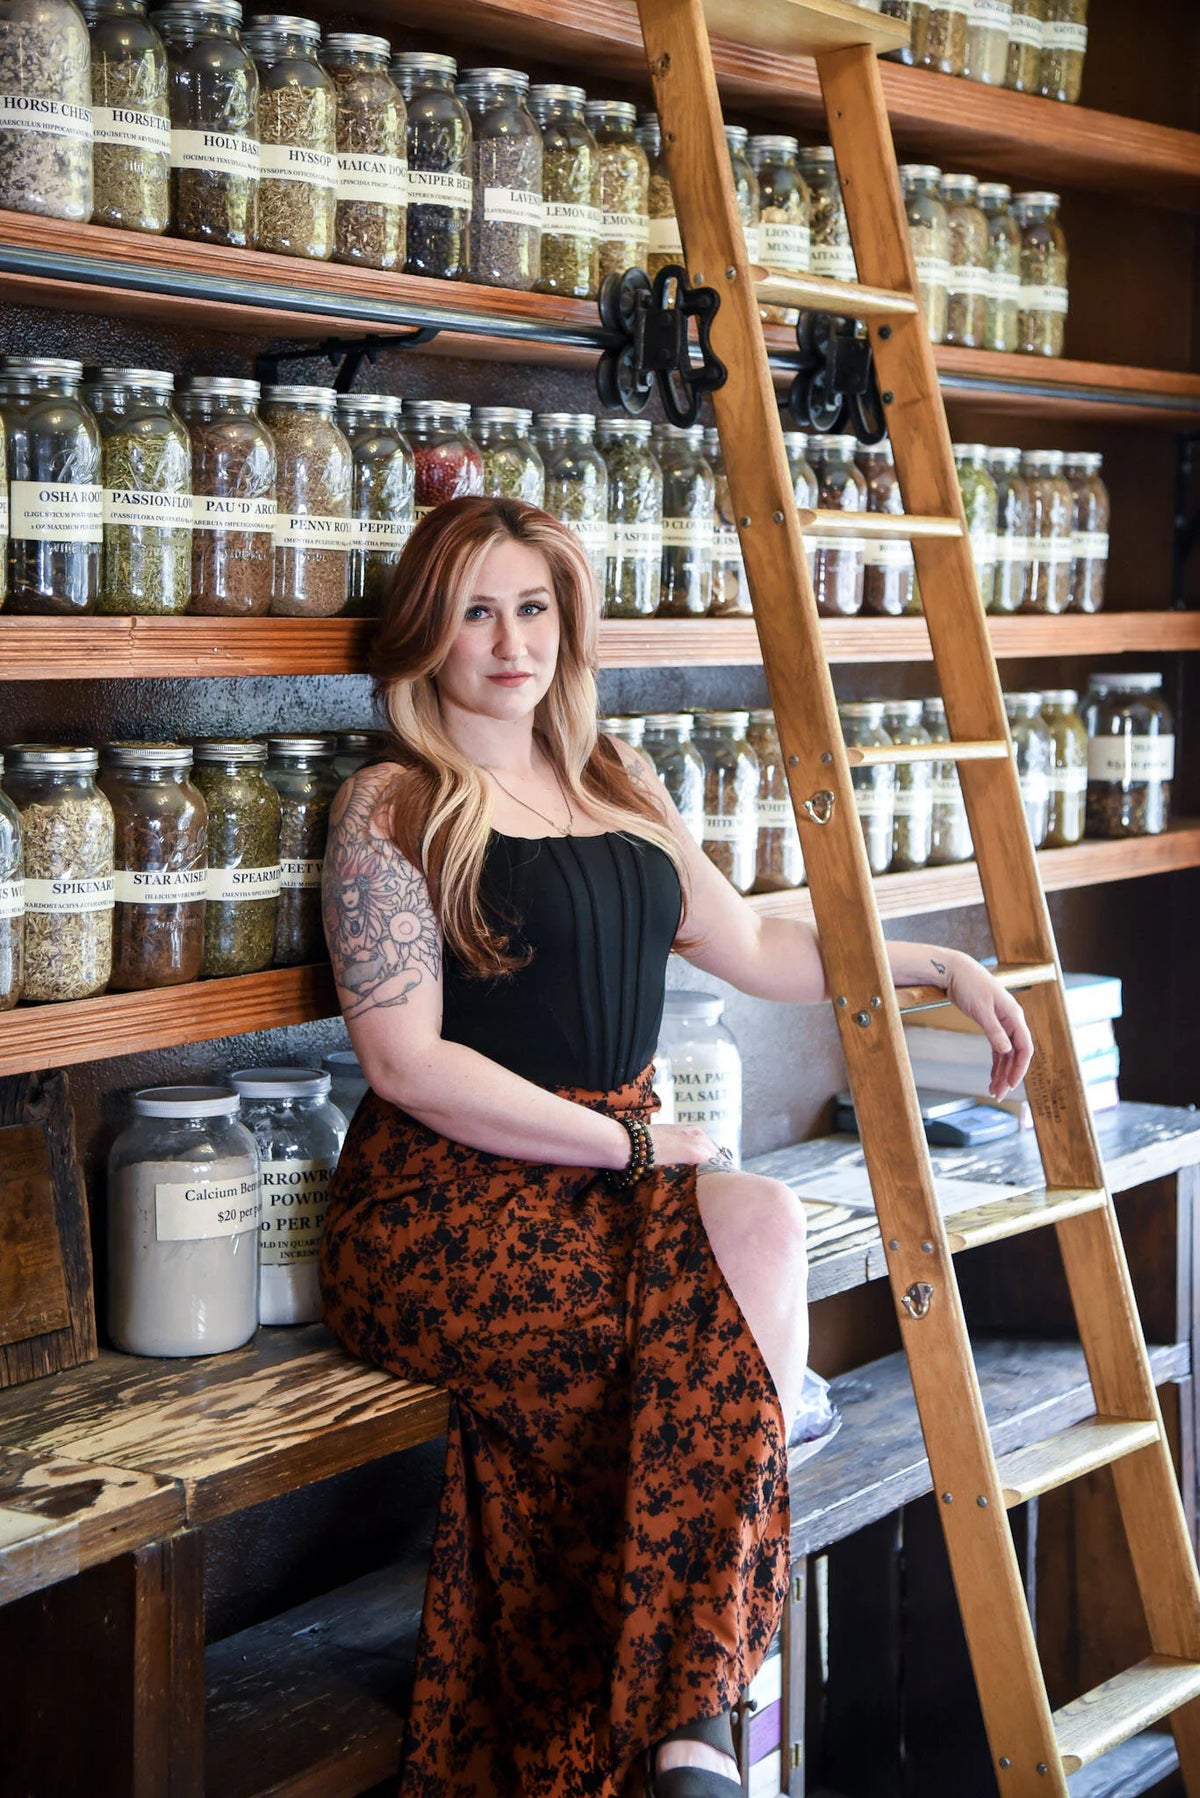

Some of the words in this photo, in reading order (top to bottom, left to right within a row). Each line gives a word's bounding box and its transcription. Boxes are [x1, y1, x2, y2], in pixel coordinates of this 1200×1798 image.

[4, 96, 58, 114] HORSE
[204, 134, 239, 151] HOLY
[183, 154, 215, 162] (OCIMUM
[289, 150, 332, 167] HYSSOP
[407, 173, 455, 188] UNIPER
[546, 206, 585, 218] LEMON
[39, 490, 79, 503] OSHA
[206, 500, 235, 513] PAU
[290, 519, 332, 531] PENNY
[133, 873, 171, 885] STAR
[174, 871, 204, 885] ANISE
[678, 1111, 706, 1122] PER
[185, 1187, 238, 1202] Calcium
[217, 1208, 237, 1223] $20
[240, 1207, 253, 1222] per
[276, 1216, 311, 1231] PER
[278, 1240, 289, 1248] IN
